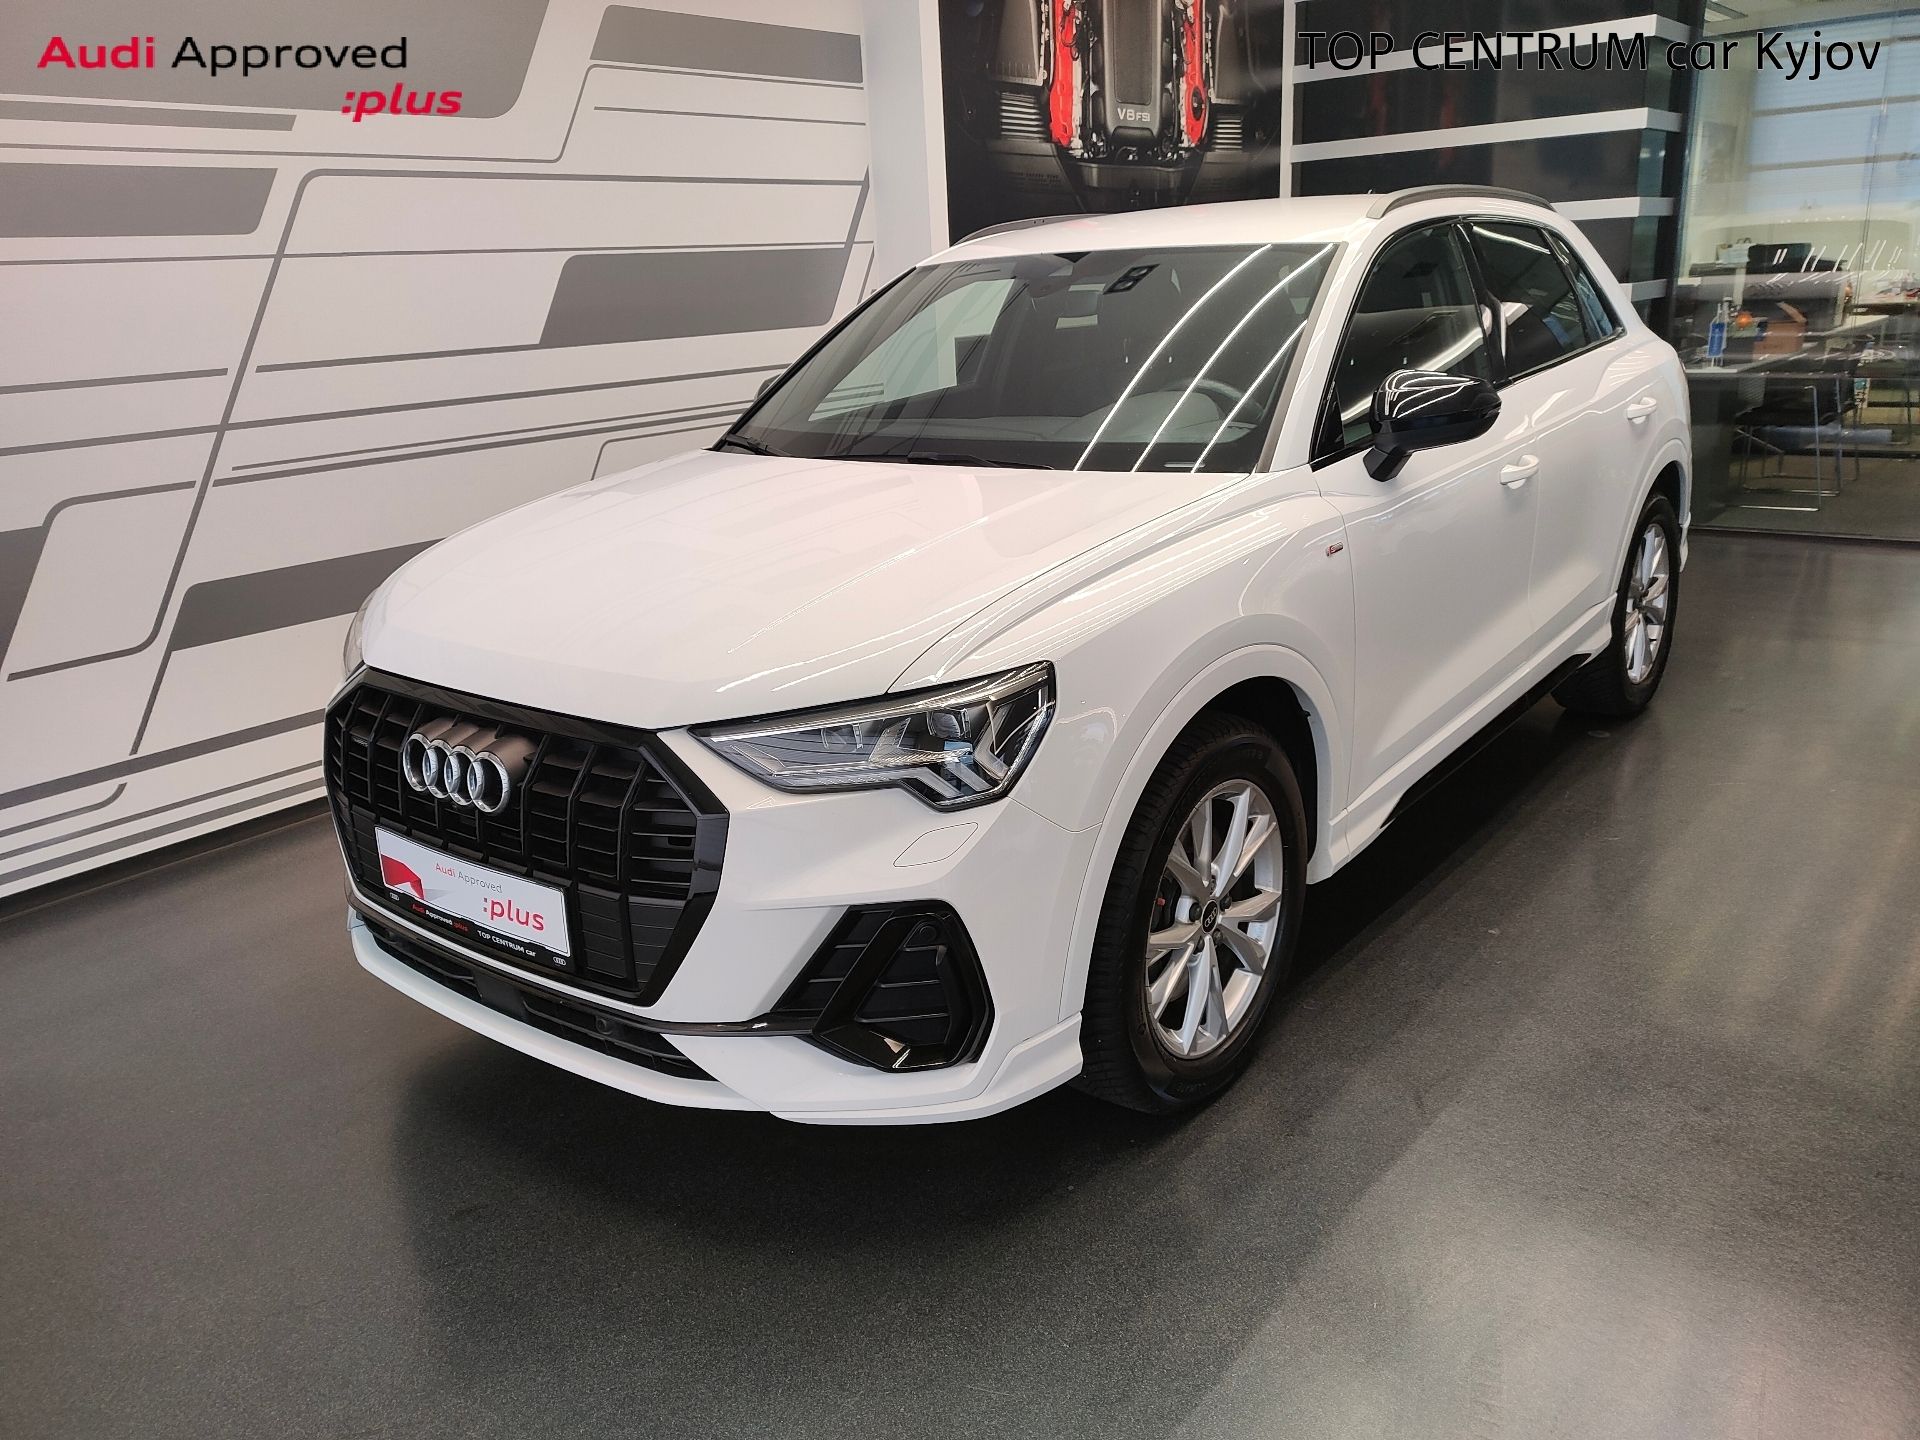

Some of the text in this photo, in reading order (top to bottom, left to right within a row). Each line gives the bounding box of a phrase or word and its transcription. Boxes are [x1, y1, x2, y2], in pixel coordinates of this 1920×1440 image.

[435, 862, 503, 894] Audi Approved
[483, 897, 545, 932] :plus
[477, 930, 537, 957] TOP CENTRUM car
